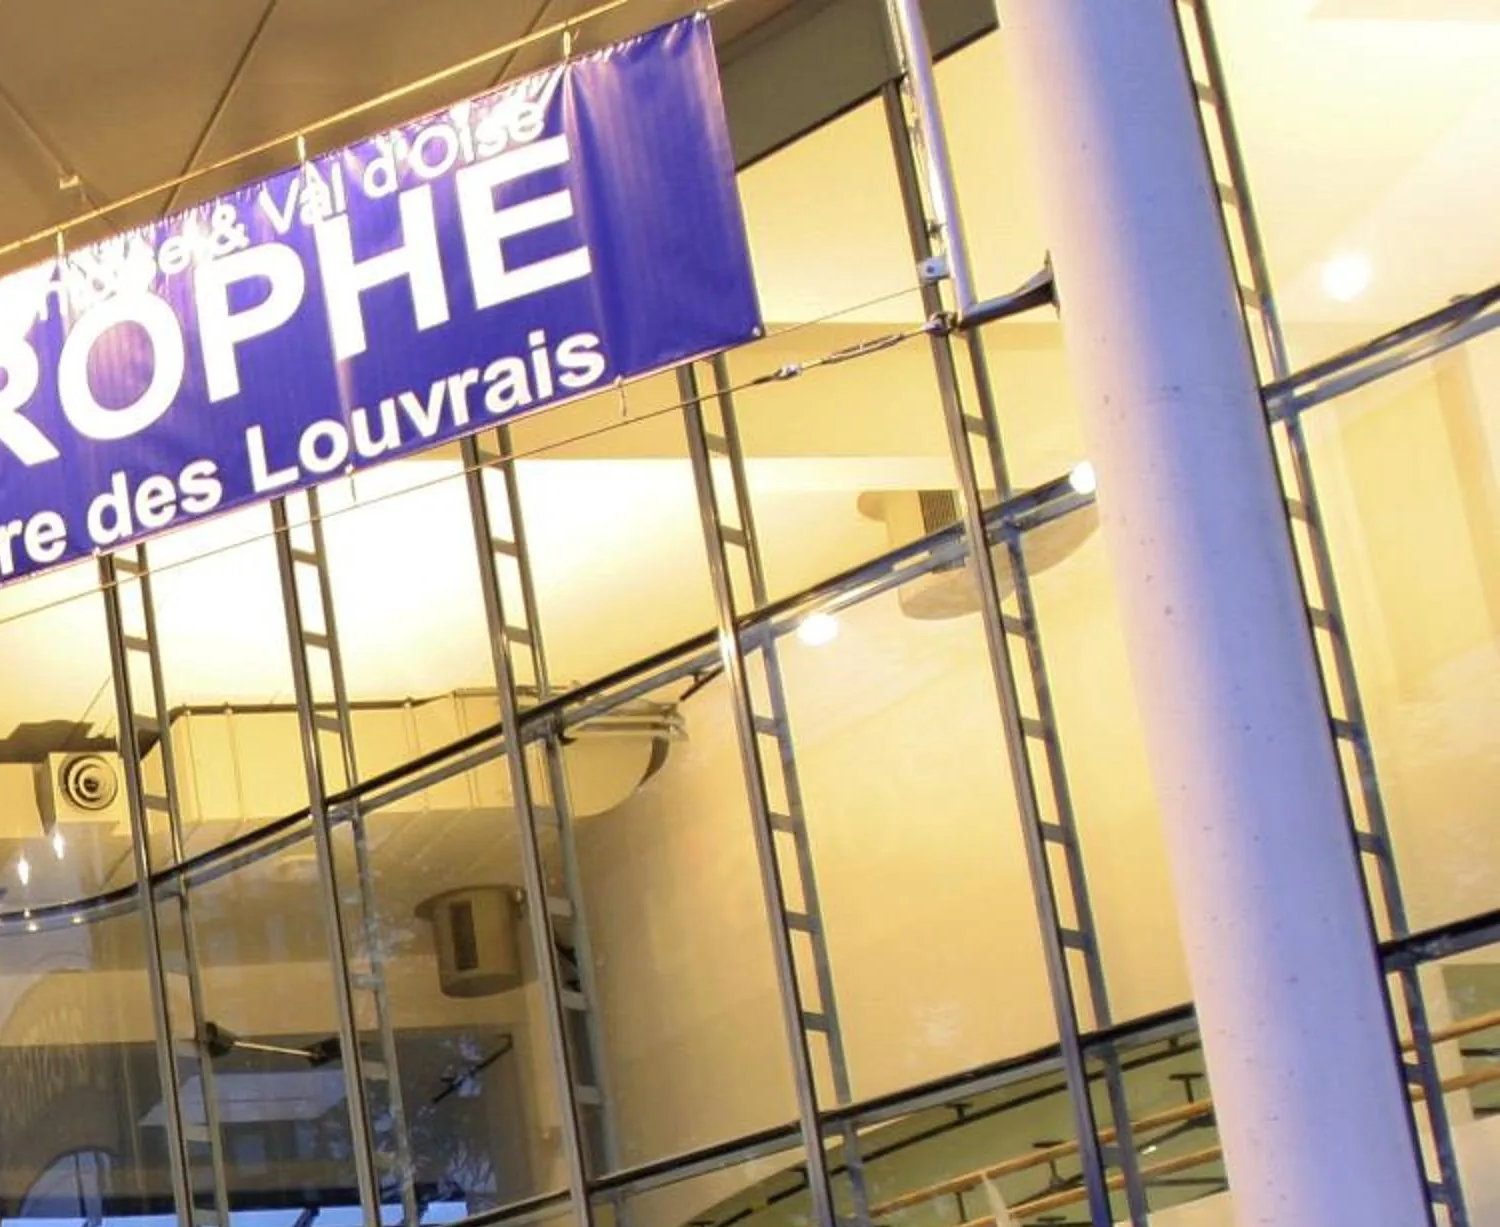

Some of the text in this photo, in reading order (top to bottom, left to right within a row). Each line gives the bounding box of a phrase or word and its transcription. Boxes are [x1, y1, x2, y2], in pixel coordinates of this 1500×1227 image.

[259, 158, 347, 234] Val
[87, 457, 223, 544] des
[246, 328, 606, 493] Louvrais
